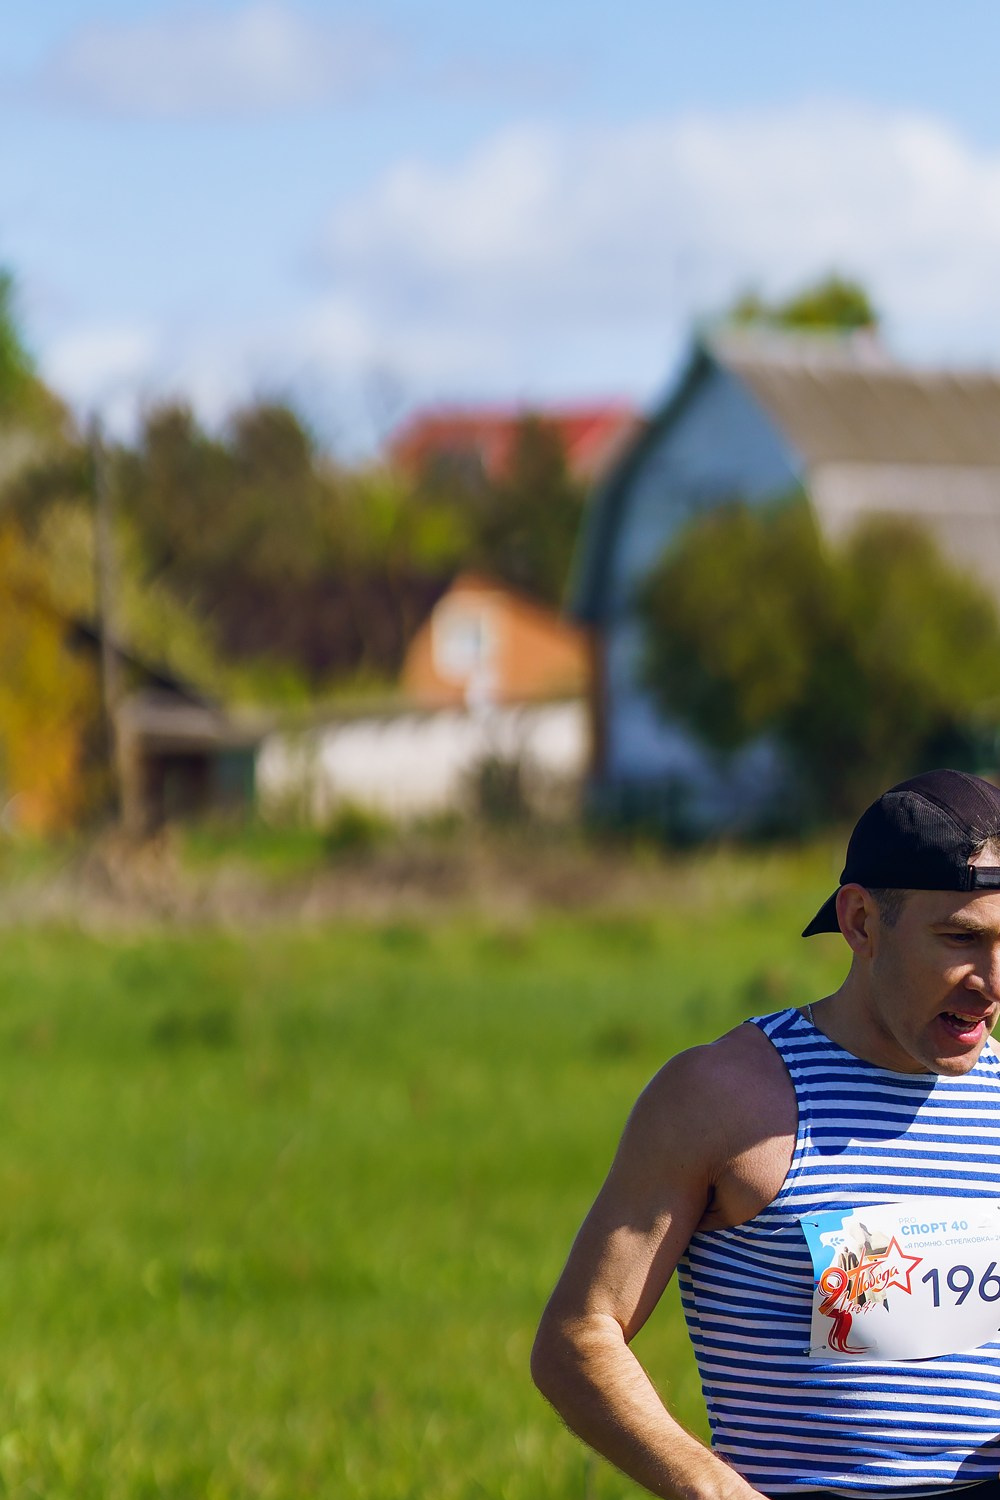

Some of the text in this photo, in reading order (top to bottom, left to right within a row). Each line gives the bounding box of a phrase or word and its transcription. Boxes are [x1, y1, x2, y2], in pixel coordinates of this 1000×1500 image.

[898, 1216, 917, 1225] PRO
[901, 1220, 969, 1236] СПОРТ 40
[818, 1266, 848, 1315] 9
